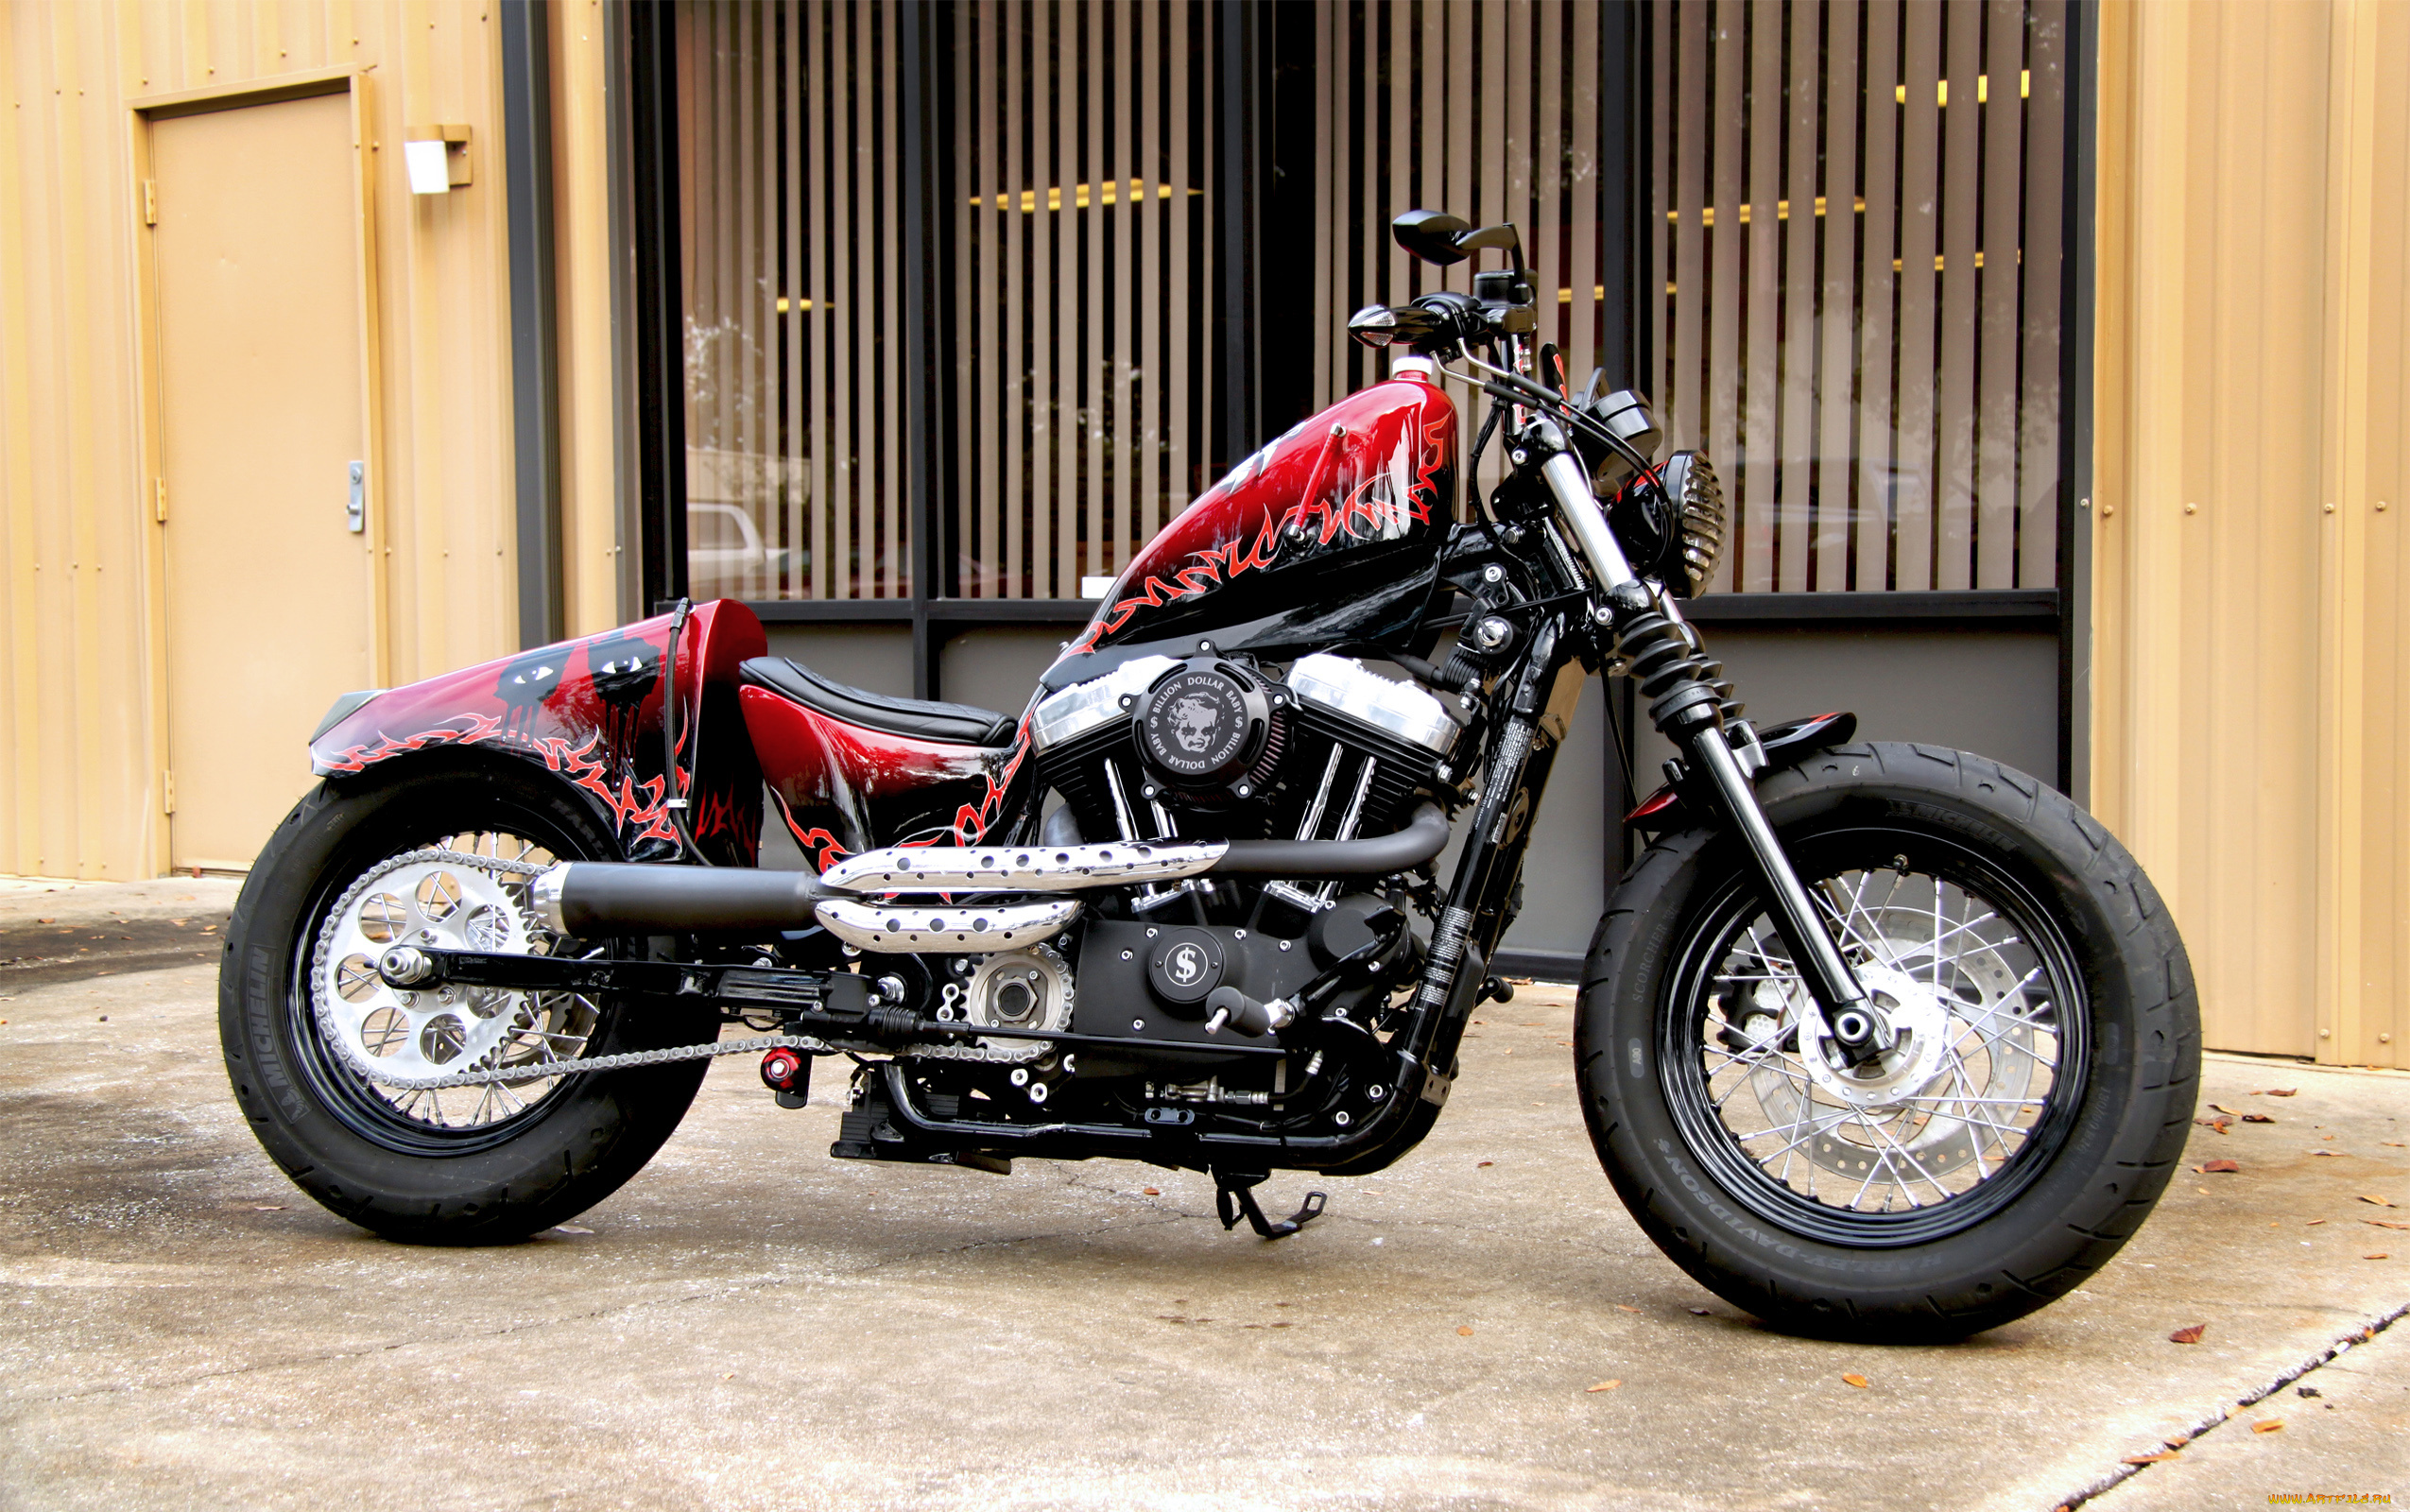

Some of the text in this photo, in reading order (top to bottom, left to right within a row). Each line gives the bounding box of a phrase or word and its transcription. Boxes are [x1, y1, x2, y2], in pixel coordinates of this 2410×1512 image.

[1152, 681, 1182, 713] BILLION
[1187, 676, 1225, 692] DOLLAR
[1226, 690, 1243, 713] BABY
[1150, 732, 1168, 756] BABY
[1168, 755, 1206, 770] DOLLAR
[1211, 731, 1241, 765] BILLION
[1175, 946, 1196, 983] $
[1632, 922, 1668, 1004] SCORCHER
[249, 946, 289, 1088] MICHELIN
[1631, 1047, 1643, 1066] A90
[1662, 1154, 1943, 1274] HARLEY-DAVIDSON
